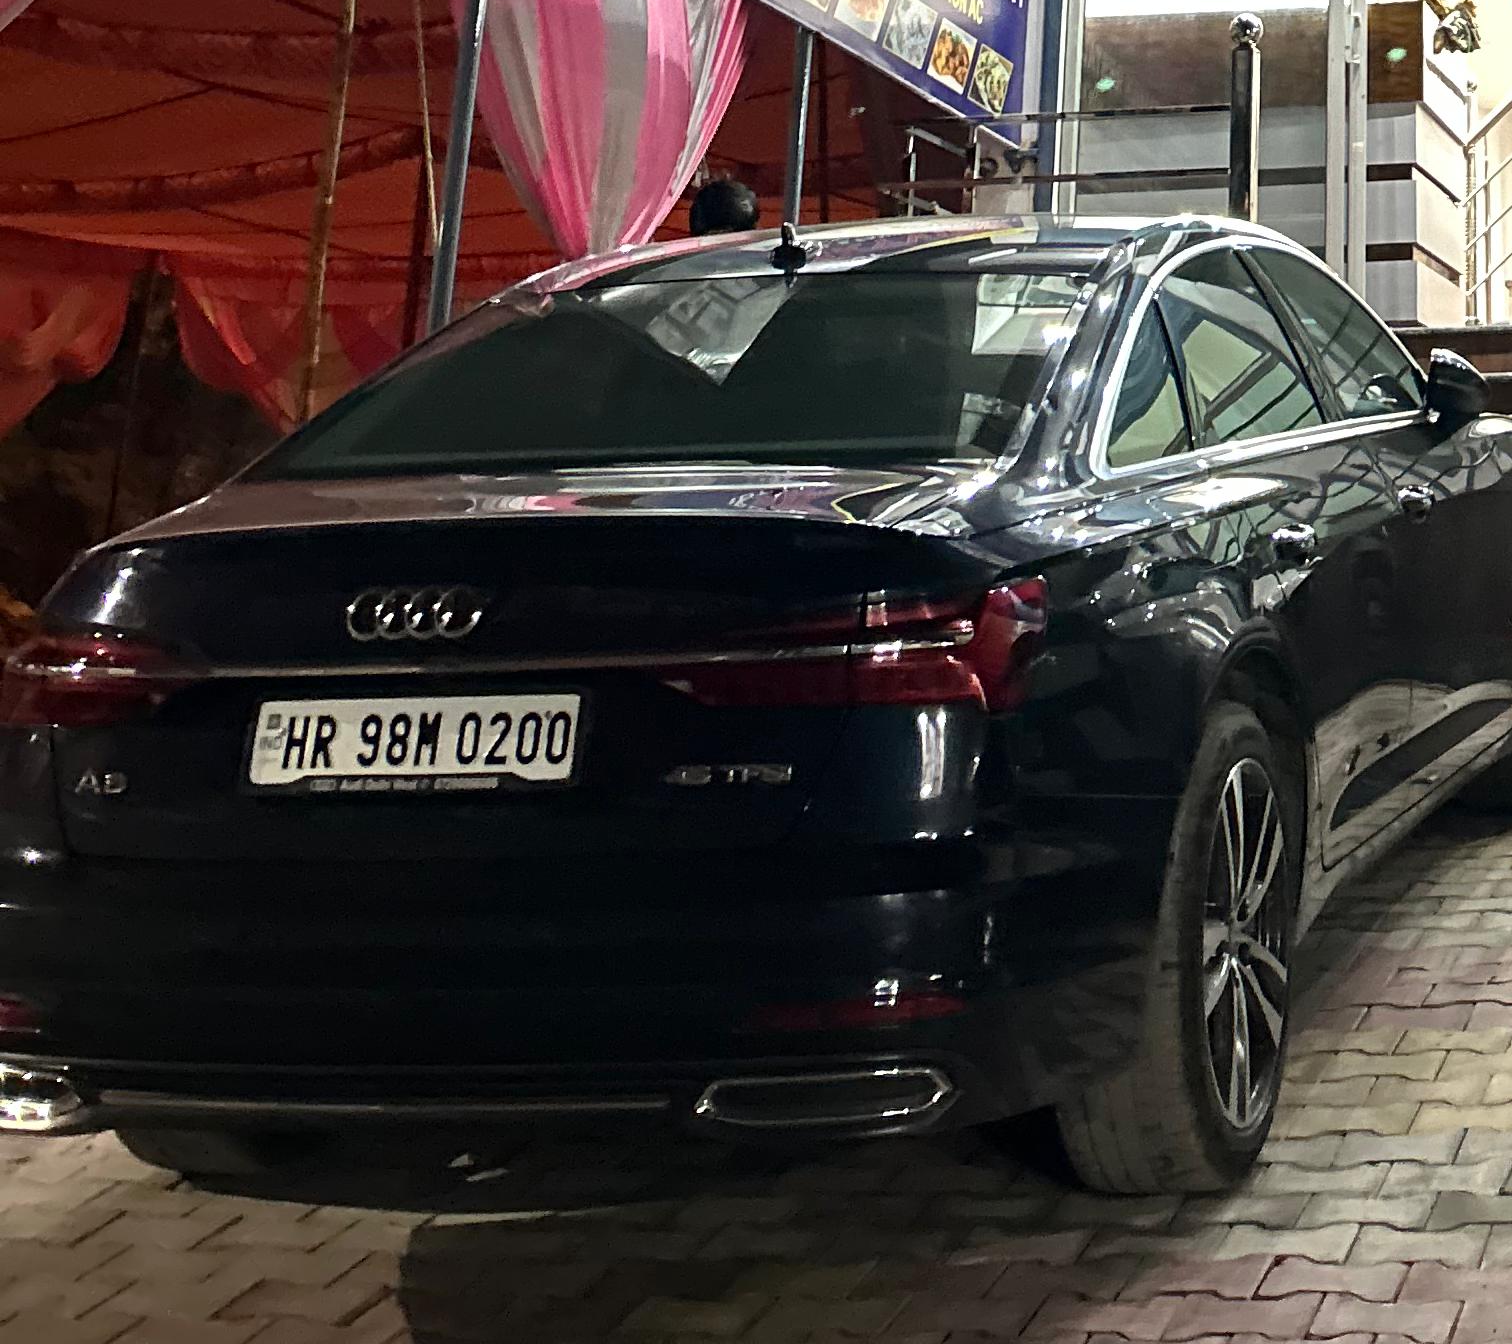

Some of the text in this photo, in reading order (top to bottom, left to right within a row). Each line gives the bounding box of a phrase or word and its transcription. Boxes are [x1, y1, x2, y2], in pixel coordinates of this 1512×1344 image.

[282, 711, 572, 769] HR 98M 0200
